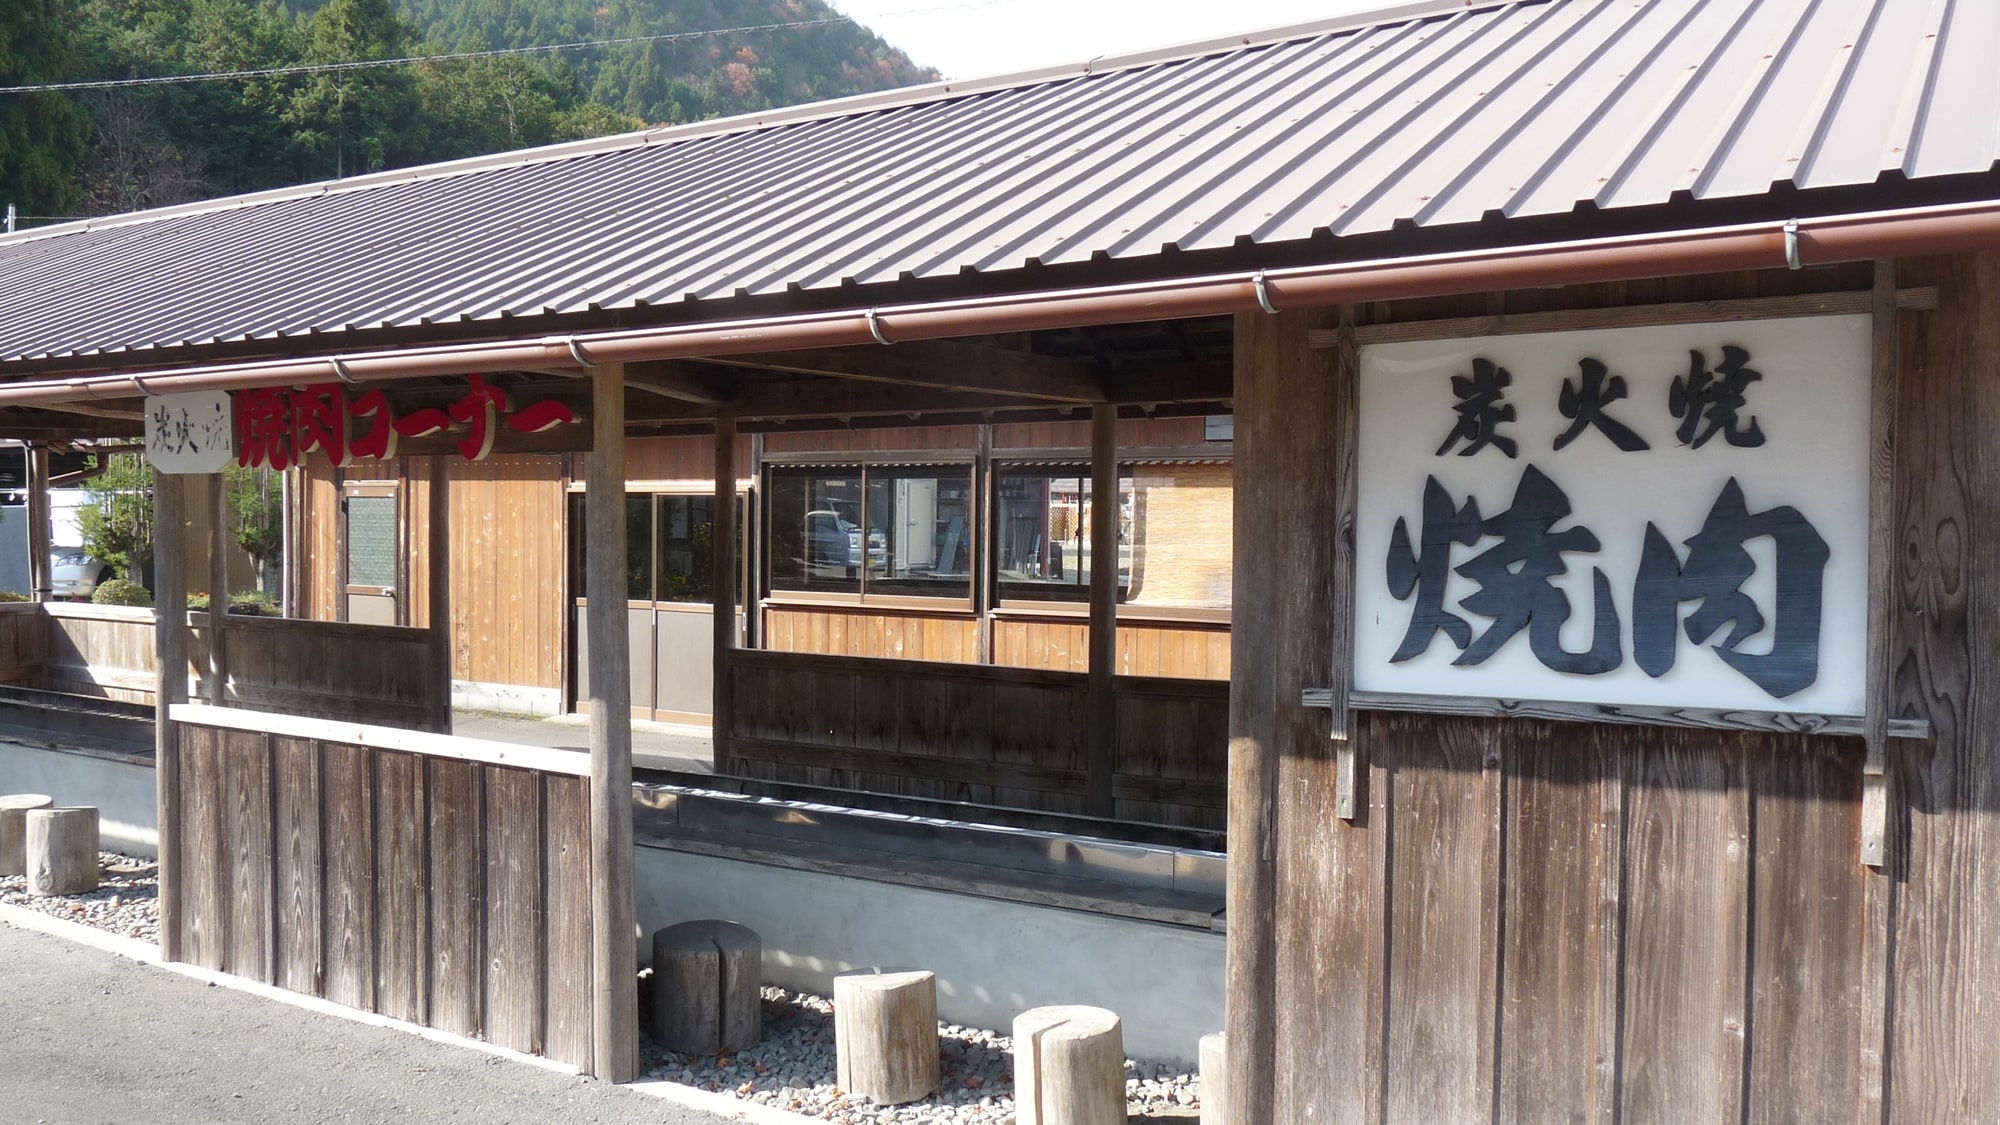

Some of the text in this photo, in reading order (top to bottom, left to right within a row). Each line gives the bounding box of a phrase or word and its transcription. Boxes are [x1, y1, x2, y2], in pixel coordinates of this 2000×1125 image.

[235, 374, 572, 470] 焼肉コーナー
[1436, 345, 1767, 458] 炭火焼
[1386, 463, 1831, 698] 焼肉
